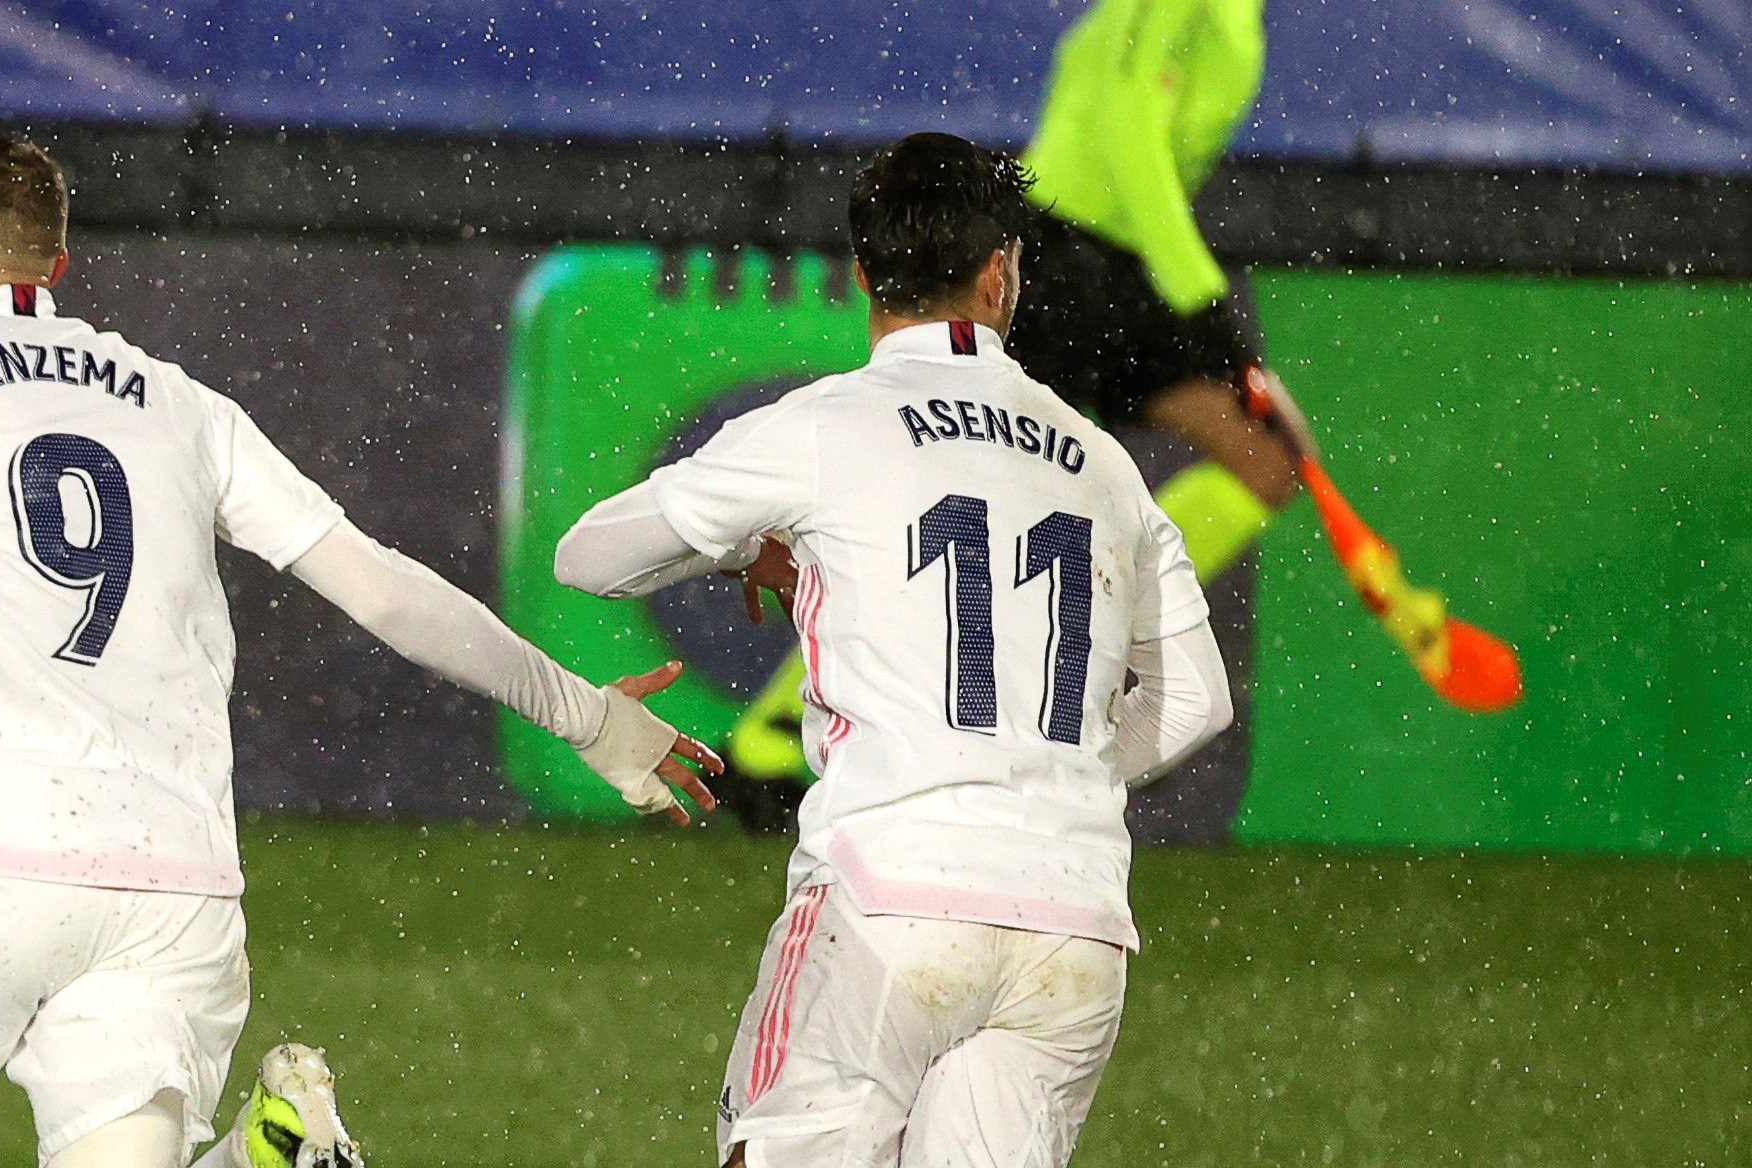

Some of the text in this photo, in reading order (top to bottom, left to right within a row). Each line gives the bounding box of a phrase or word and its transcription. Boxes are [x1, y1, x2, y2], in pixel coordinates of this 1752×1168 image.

[8, 432, 135, 668] 9
[898, 399, 1086, 475] ASENSIO
[906, 494, 1093, 746] 11
